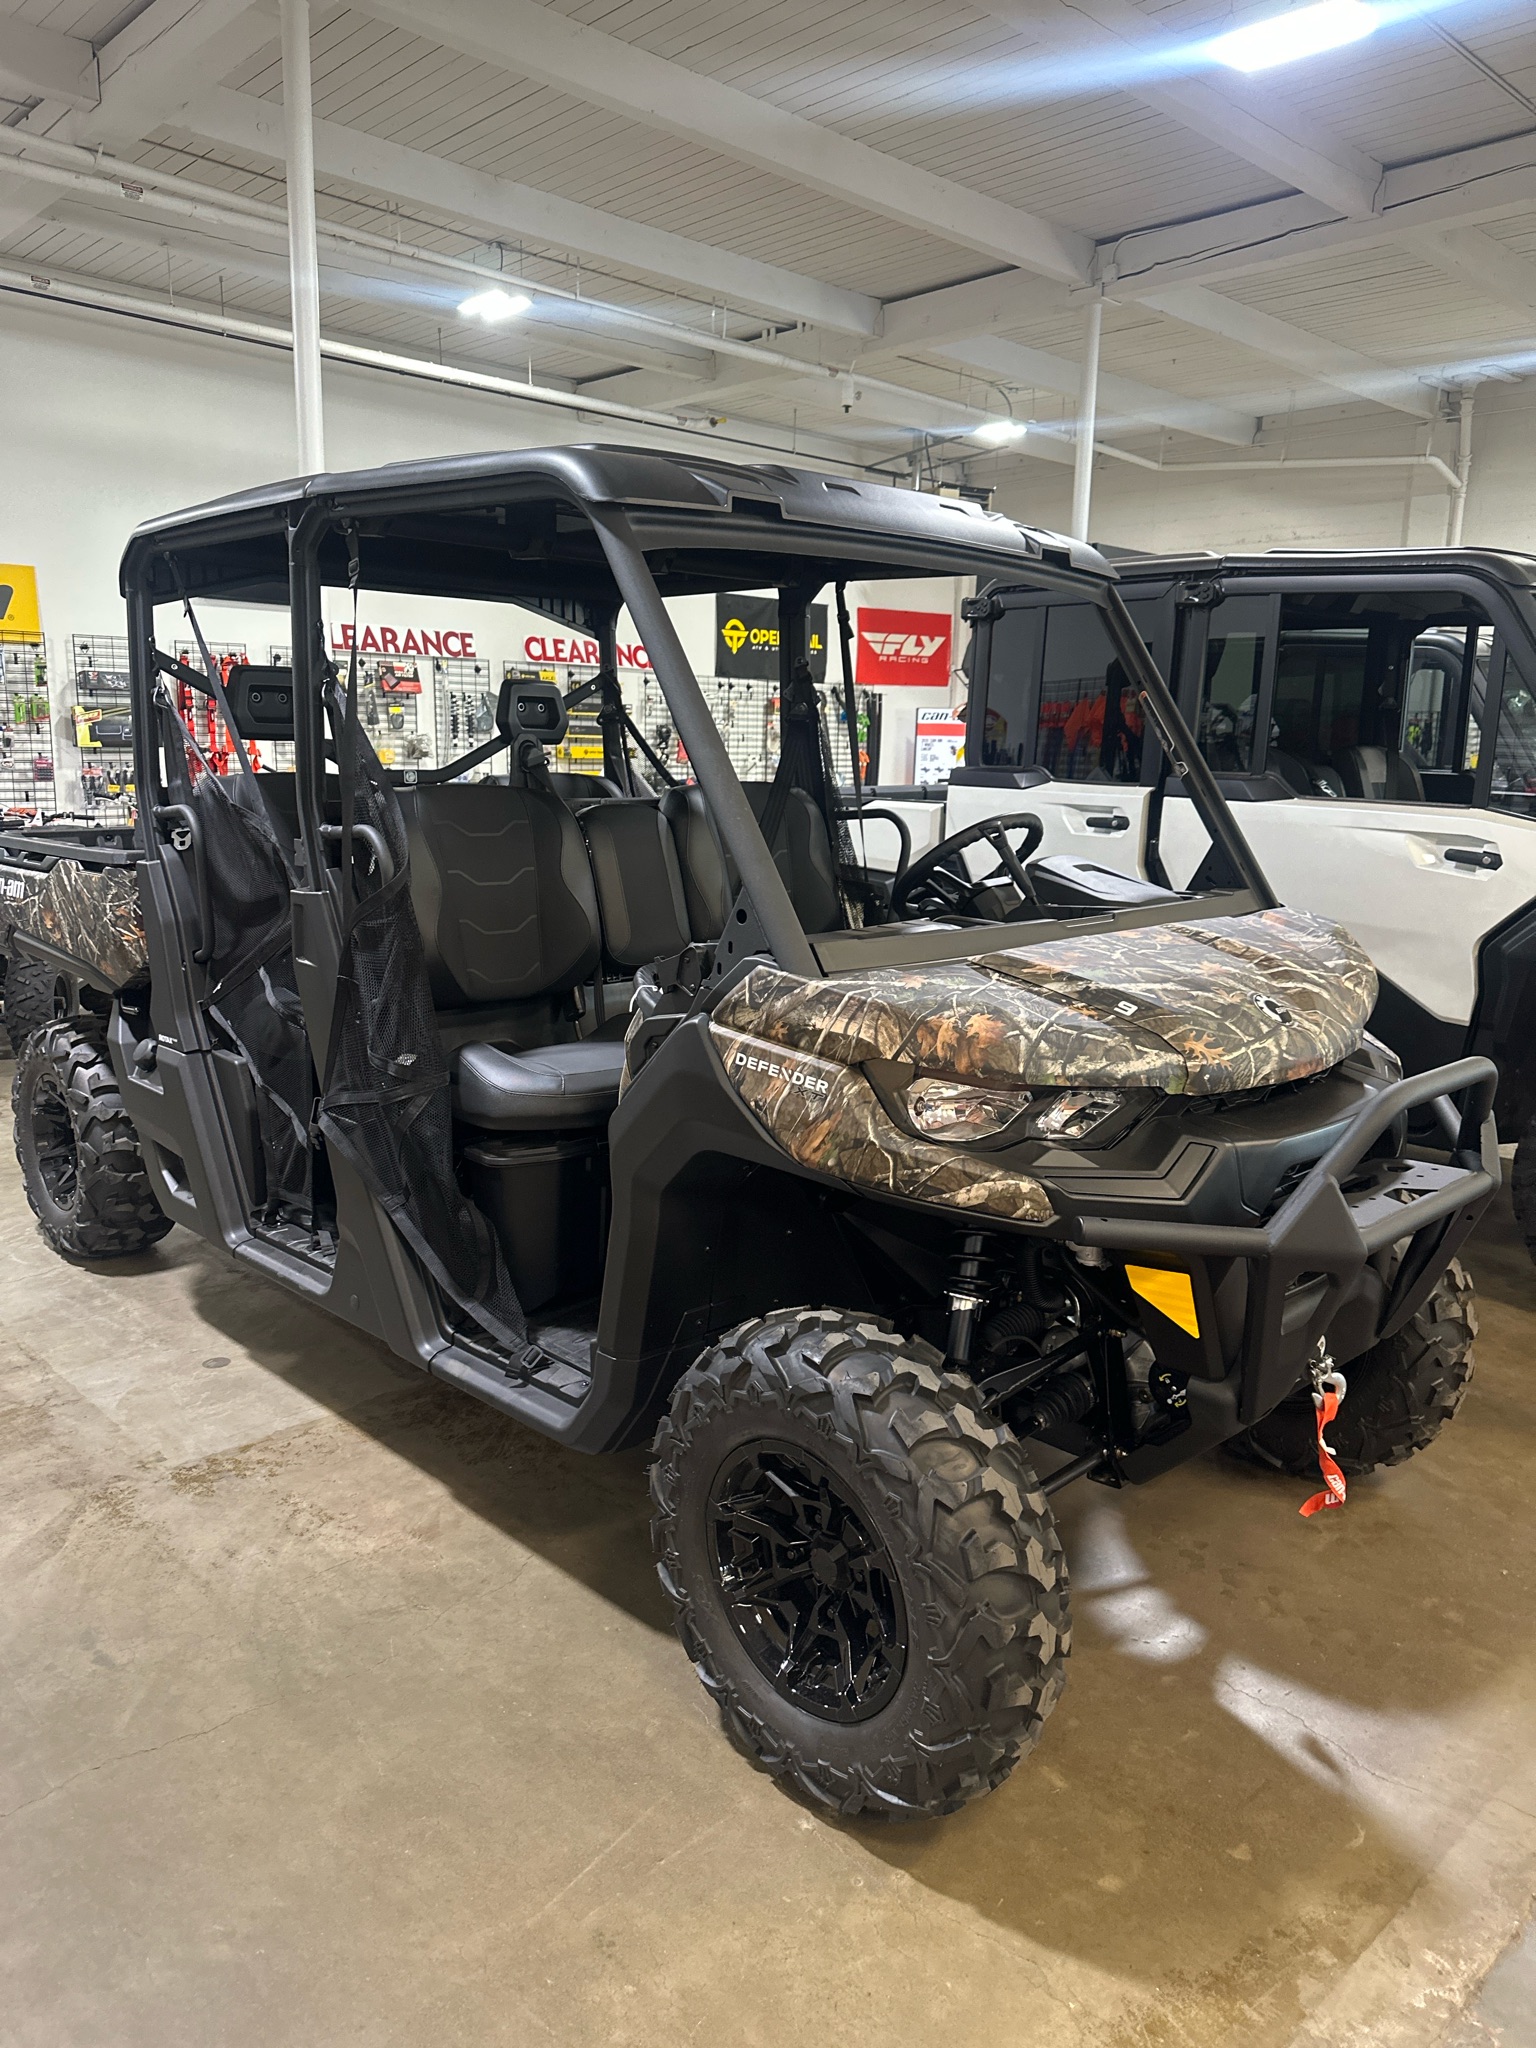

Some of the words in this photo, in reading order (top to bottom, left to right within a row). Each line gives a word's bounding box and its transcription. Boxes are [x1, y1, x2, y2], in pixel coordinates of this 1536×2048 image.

[330, 623, 477, 658] LEARANCE
[750, 628, 780, 646] OPE
[861, 631, 946, 657] FLY
[525, 636, 653, 669] CLEARNC
[879, 655, 928, 664] RACING
[921, 712, 953, 720] can-
[0, 877, 25, 899] n-am
[1113, 1000, 1139, 1017] 9
[735, 1052, 829, 1094] DEFENDER
